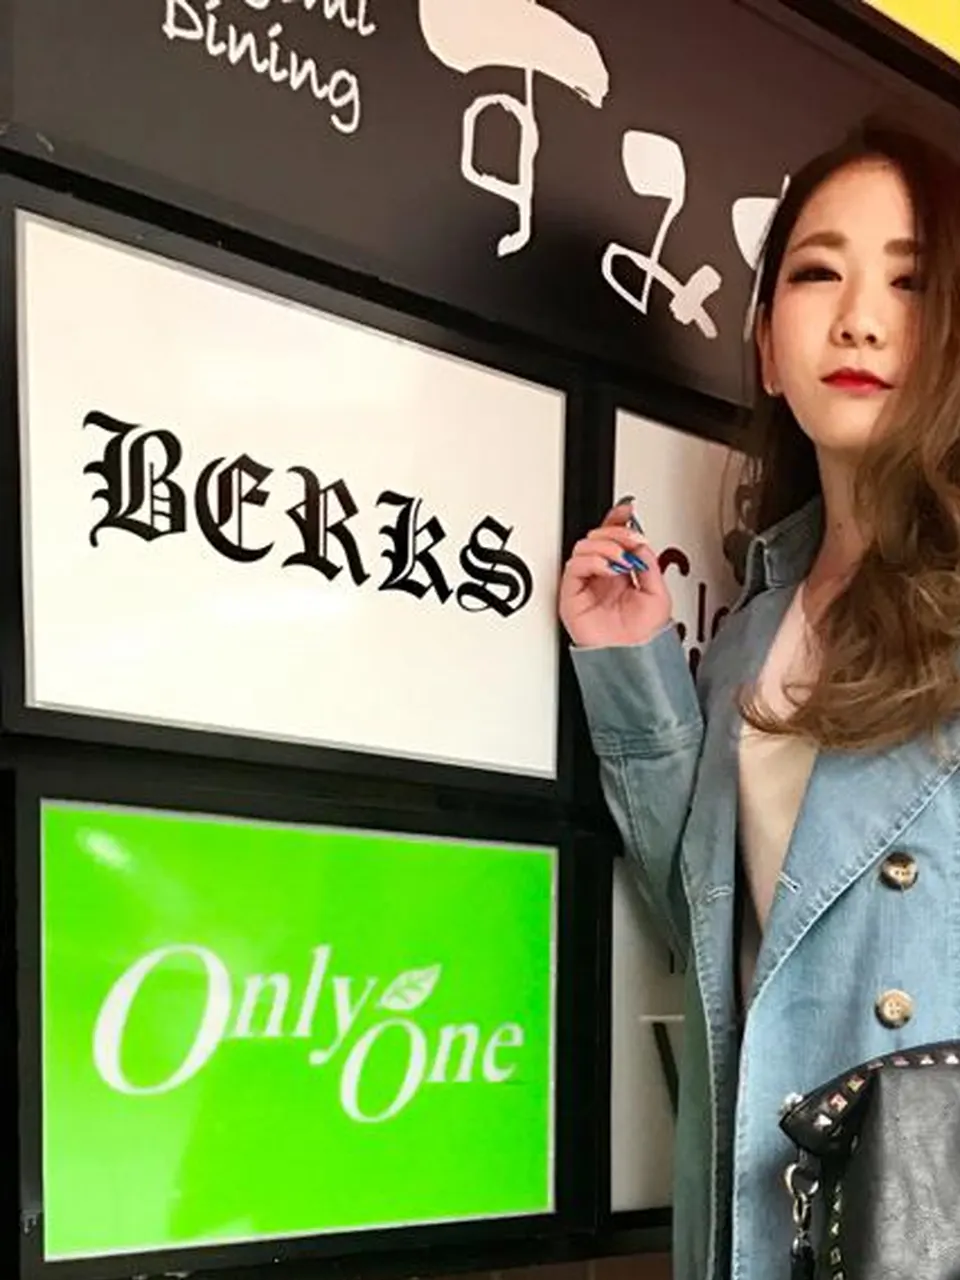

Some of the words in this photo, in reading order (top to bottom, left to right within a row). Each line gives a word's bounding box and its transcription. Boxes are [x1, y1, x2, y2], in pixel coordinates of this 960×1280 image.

[162, 0, 361, 133] Dining
[419, 0, 787, 338] すみ
[93, 944, 379, 1095] Only
[339, 1012, 525, 1123] One
